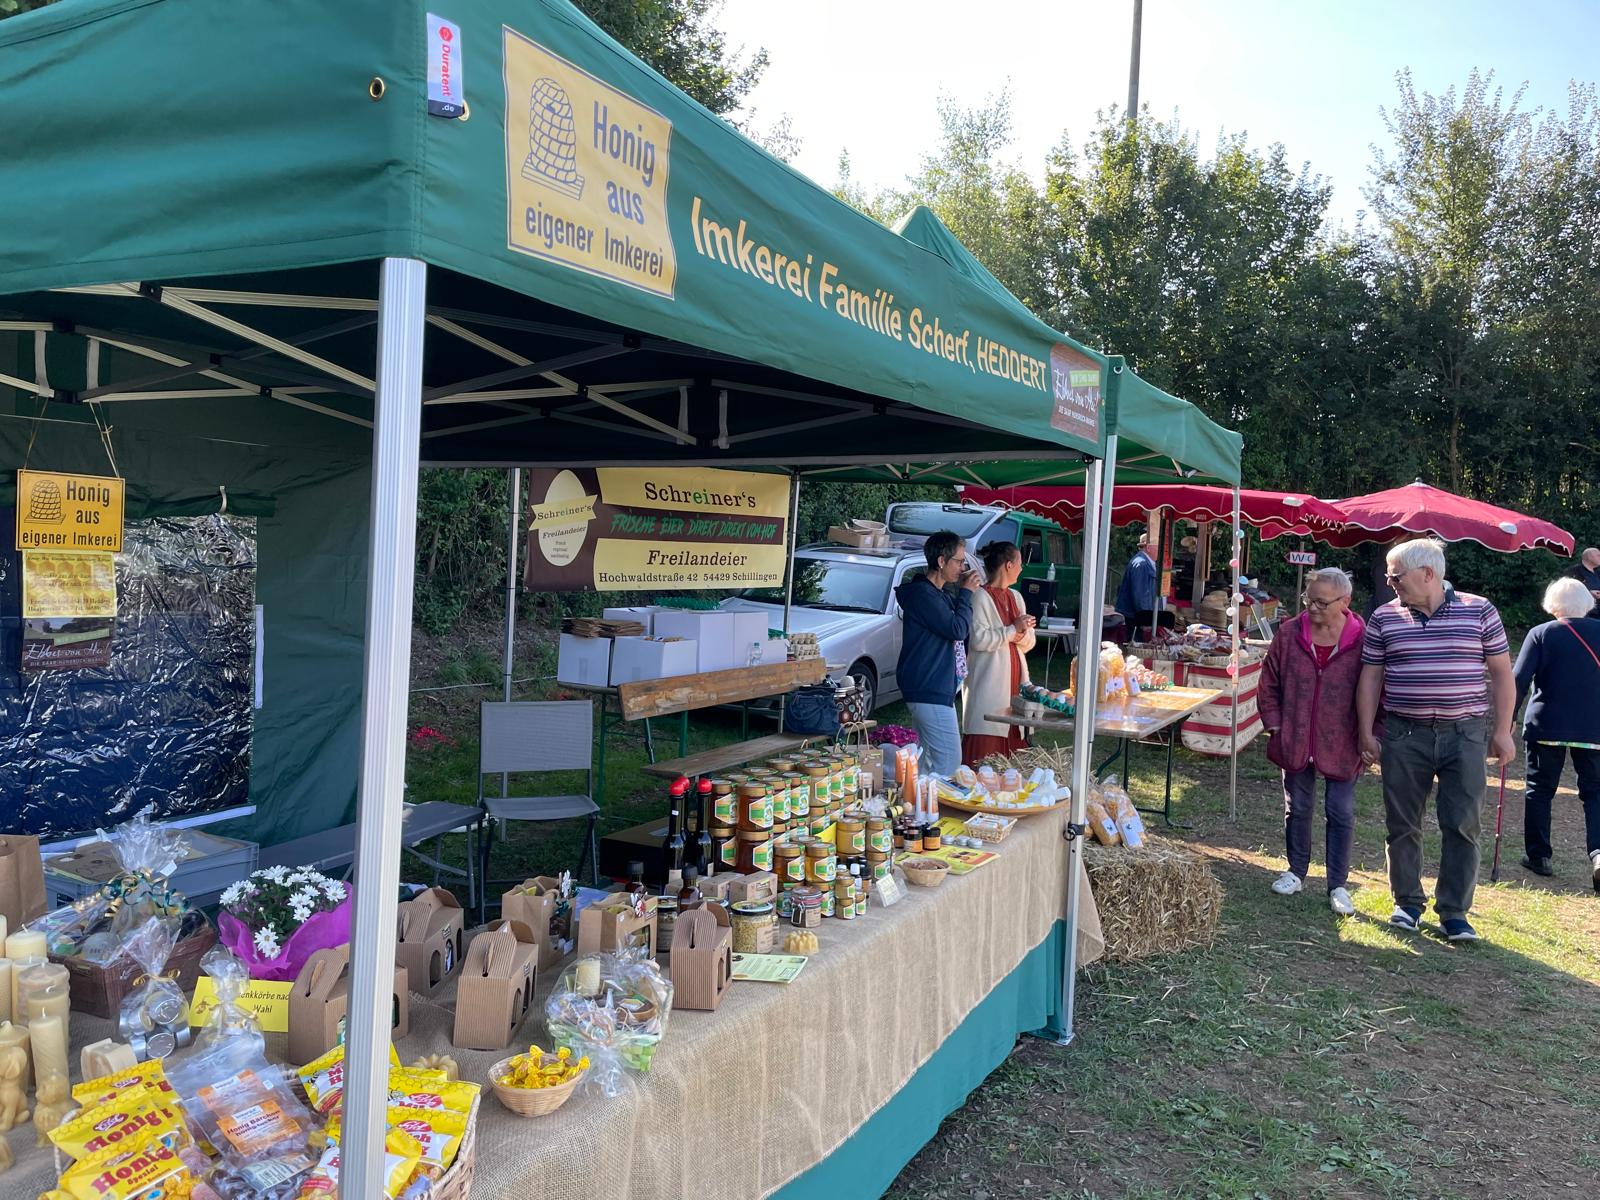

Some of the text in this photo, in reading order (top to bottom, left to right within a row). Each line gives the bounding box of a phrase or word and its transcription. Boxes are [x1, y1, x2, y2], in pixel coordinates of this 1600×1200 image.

[441, 44, 452, 97] Duratent
[593, 101, 655, 187] Honig
[606, 180, 644, 225] aus
[525, 202, 664, 278] eigener Imkerei
[691, 196, 1047, 392] Imkerei Familie Scherf, HEDDERT
[66, 480, 110, 507] Honig
[644, 481, 756, 508] Schreiner's
[75, 508, 100, 525] aus
[537, 505, 592, 520] Schreiner's
[610, 512, 657, 534] FRISCHE
[659, 512, 685, 535] EIER
[687, 515, 721, 537] DIREKT
[22, 531, 117, 547] eigener Imkerei
[543, 526, 587, 539] Freilandeier
[646, 550, 748, 566] Freilandeier
[1291, 553, 1314, 562] WC
[599, 572, 778, 583] Hochwaldstraße 42 54429 Schillingen
[254, 1005, 272, 1013] Wahl
[84, 1111, 162, 1152] Honig
[91, 1146, 174, 1194] Honig
